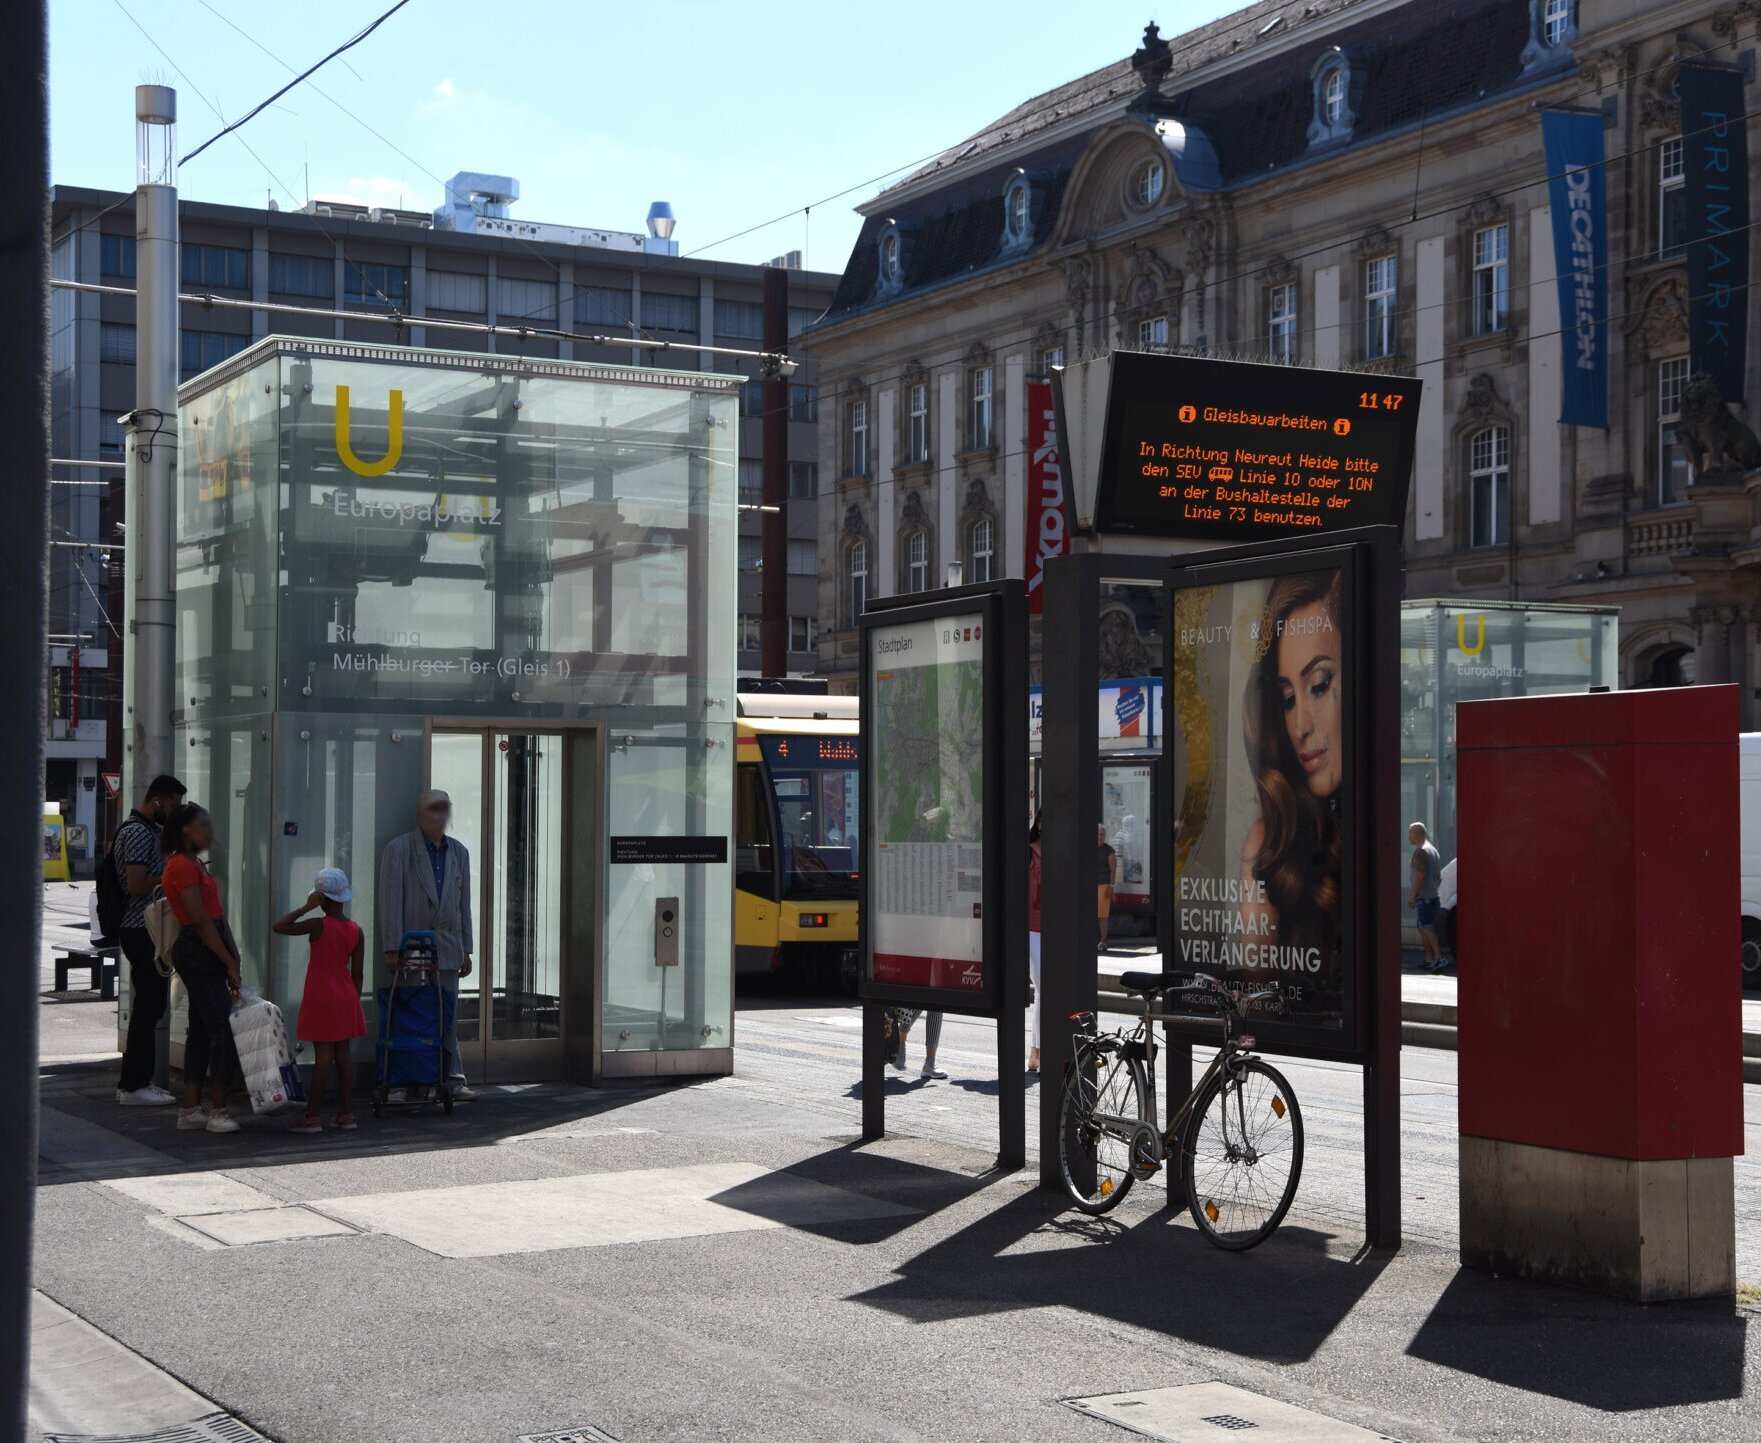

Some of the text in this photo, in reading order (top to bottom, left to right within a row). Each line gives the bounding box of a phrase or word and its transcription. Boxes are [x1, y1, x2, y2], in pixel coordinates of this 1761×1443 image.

[1701, 111, 1731, 347] PRIMARK
[1565, 164, 1595, 371] DECATHLON
[335, 384, 403, 477] U
[1203, 407, 1328, 431] Gleisbauarbeiten
[1140, 441, 1379, 473] In Richtung Neureut Heide bitte
[1142, 462, 1373, 492] den SEV Linie 10 oder 10N
[333, 492, 502, 528] Europaplatz
[1159, 484, 1351, 510] an der Bushaltestelle der
[1184, 504, 1323, 527] Linie 73 benutzen.
[1181, 625, 1231, 646] BEAUTY
[1276, 615, 1333, 638] FISHSPA
[1457, 613, 1485, 657] U
[878, 636, 913, 655] Stadtplan
[333, 653, 571, 679] Mühlburger Tor (Gleis 1)
[1457, 664, 1524, 679] Europaplatz
[778, 739, 858, 758] 4 Walds
[1180, 877, 1266, 904] EXKLUSIVE
[1180, 907, 1277, 936] ECHTHAAR-
[1180, 936, 1322, 973] VERLÄNGERUNG
